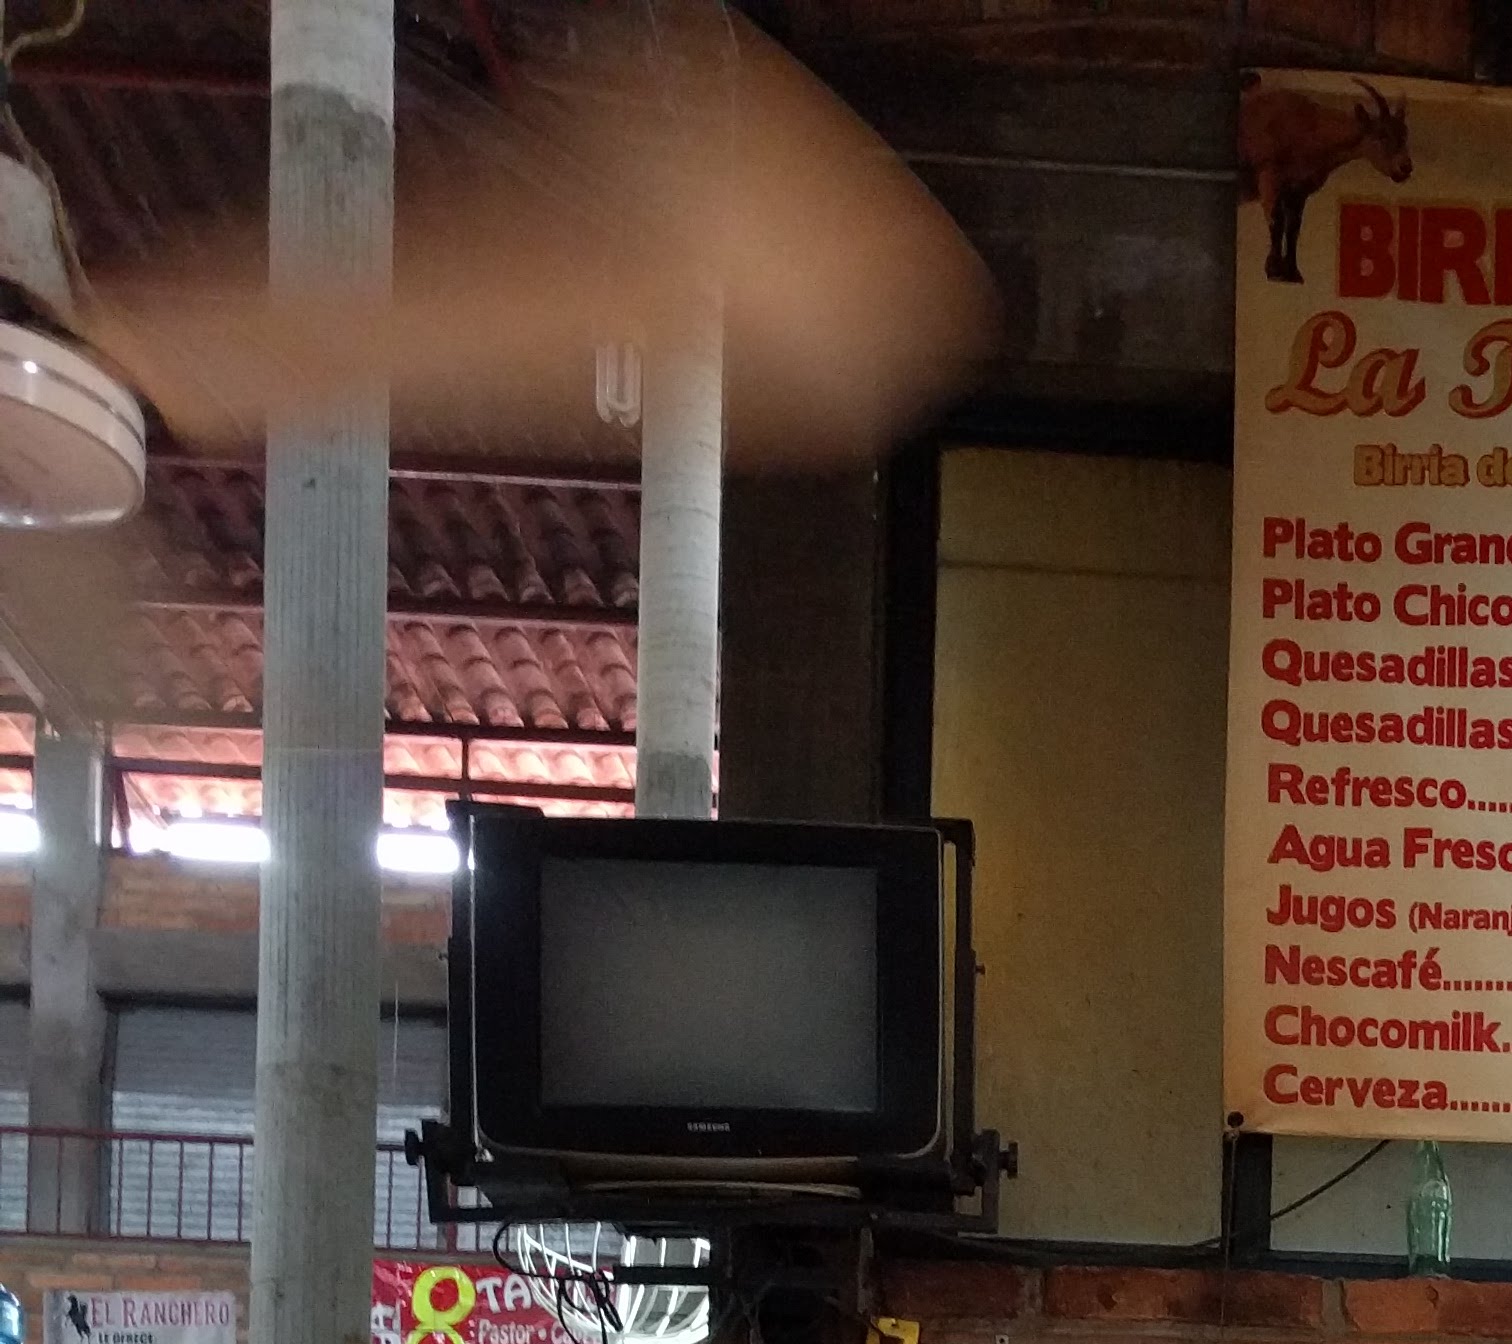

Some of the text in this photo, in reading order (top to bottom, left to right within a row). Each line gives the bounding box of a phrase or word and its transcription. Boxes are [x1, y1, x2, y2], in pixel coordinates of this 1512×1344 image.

[1265, 311, 1427, 418] La
[1353, 443, 1469, 487] Birria
[1262, 516, 1383, 564] Plato
[1261, 577, 1382, 624] Plato
[1267, 762, 1467, 809] Refresco
[1267, 824, 1391, 872] Agua
[1266, 883, 1397, 934] Jugos
[1264, 944, 1443, 991] Nescafé
[1264, 1004, 1502, 1053] Chocomilk
[1263, 1064, 1449, 1111] Cerveza
[121, 1296, 230, 1328] RANCHERO
